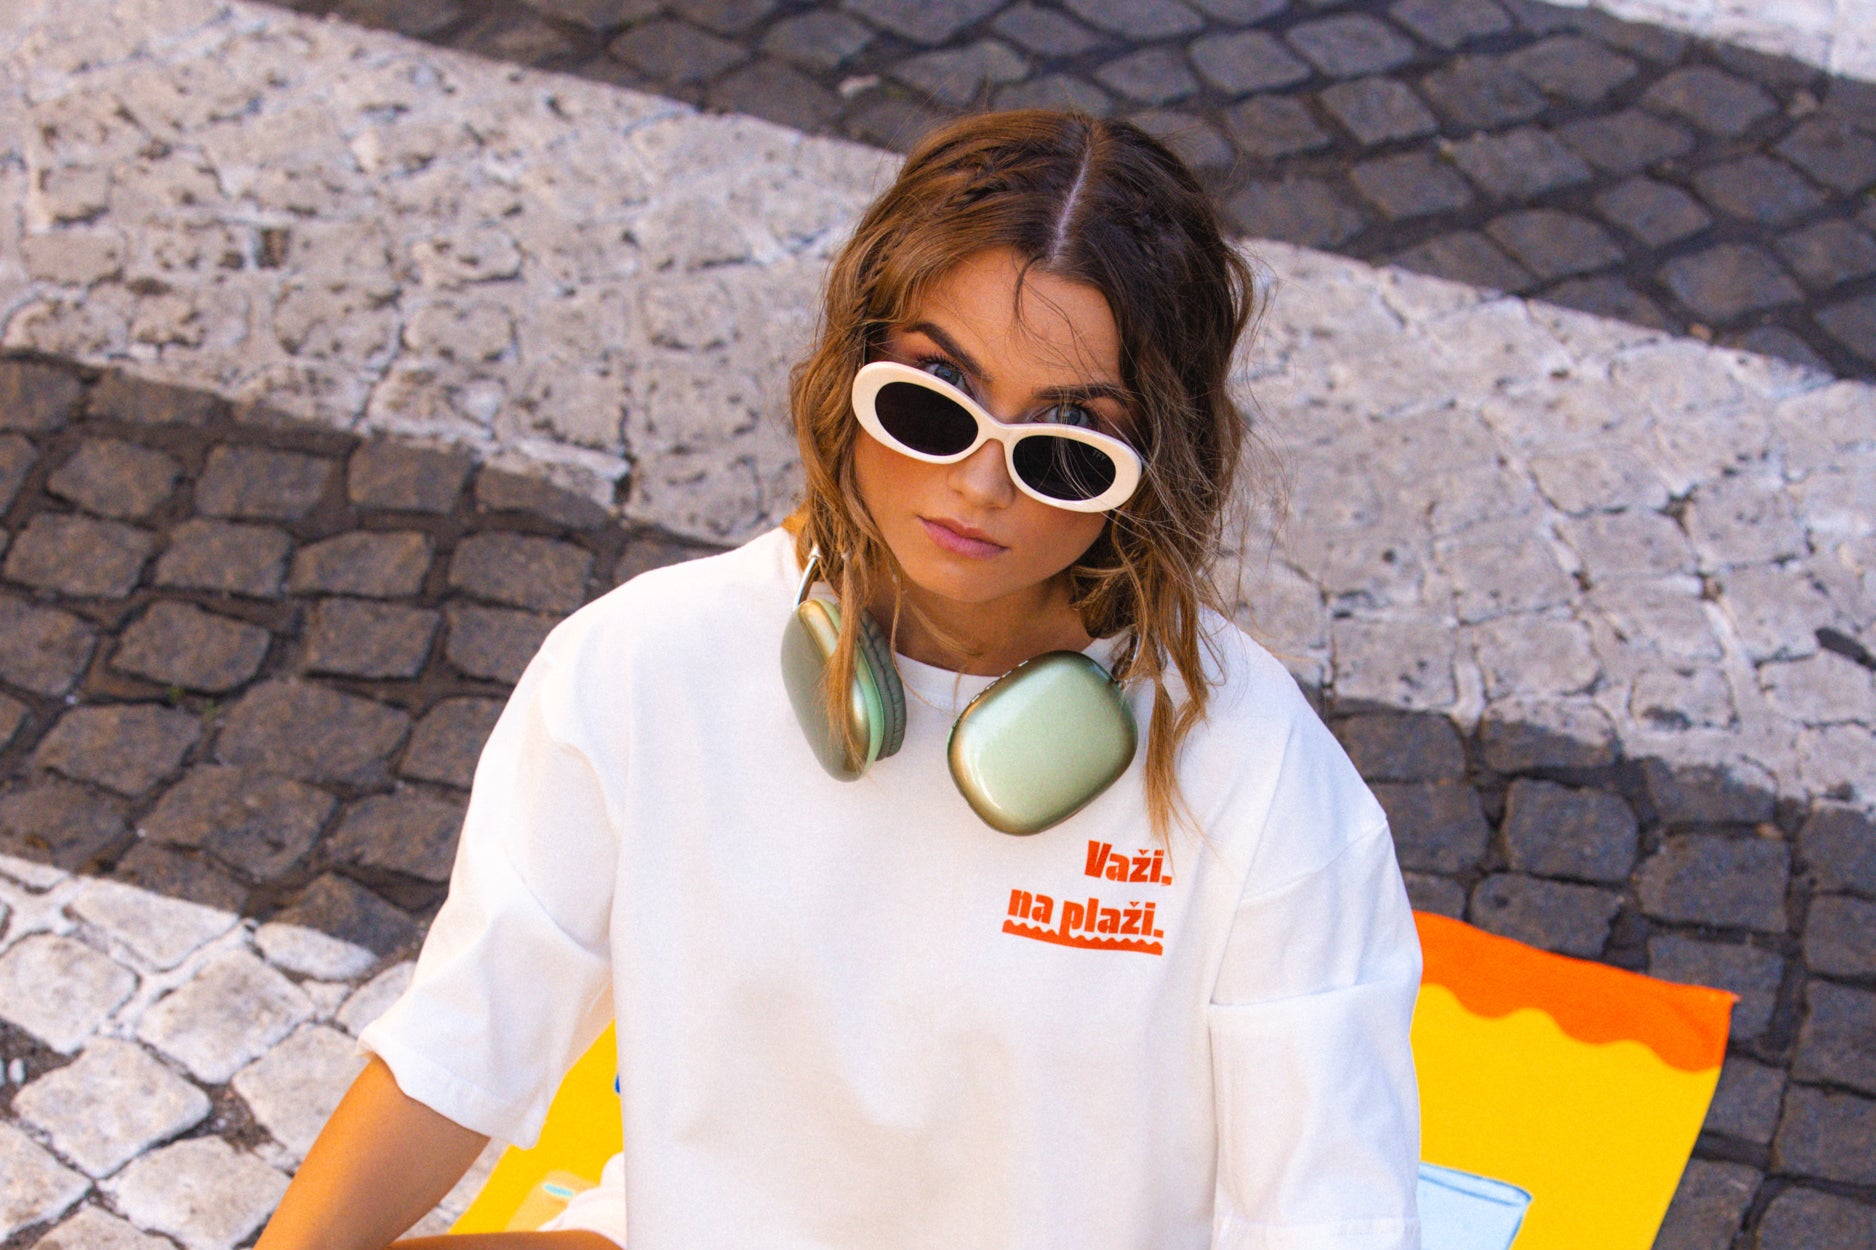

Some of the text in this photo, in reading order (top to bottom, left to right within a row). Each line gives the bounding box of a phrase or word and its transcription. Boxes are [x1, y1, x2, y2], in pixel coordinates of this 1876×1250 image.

[1084, 839, 1173, 886] Važi.
[1007, 888, 1165, 939] na plaži.
